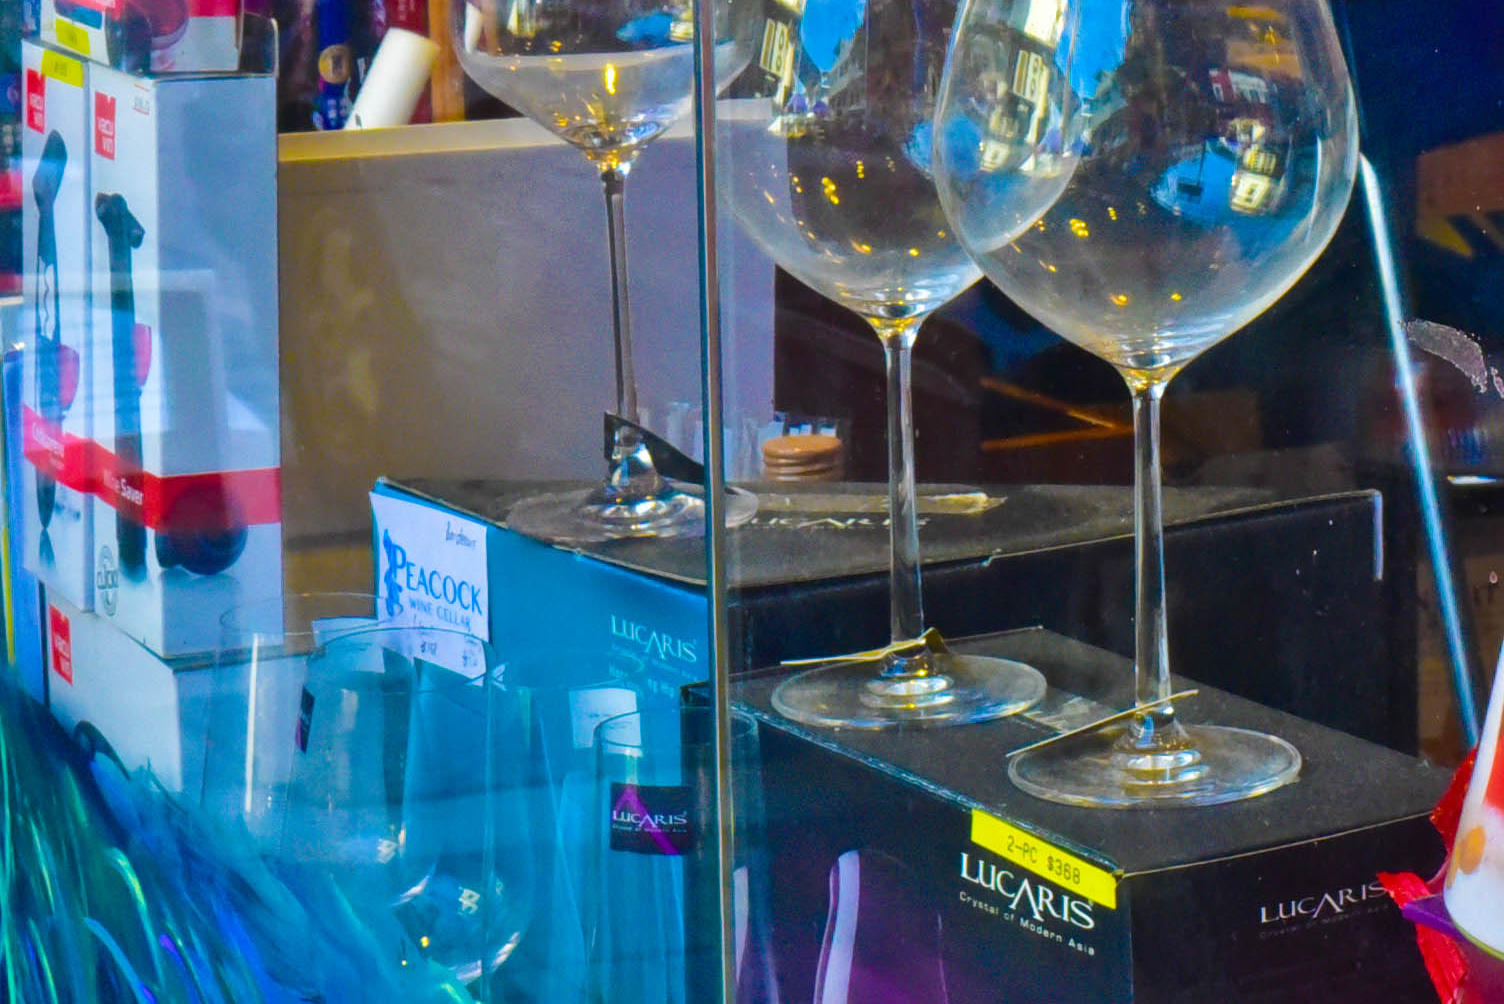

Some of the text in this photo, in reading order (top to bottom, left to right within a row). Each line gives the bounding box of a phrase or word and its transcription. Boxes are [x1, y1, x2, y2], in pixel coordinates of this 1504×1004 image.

[391, 542, 483, 616] PEACOCK
[409, 597, 472, 631] WINE CELLAR
[611, 614, 697, 663] LUCARIS
[612, 810, 688, 828] LUCARIS
[1006, 835, 1038, 864] 2-PC
[960, 852, 1095, 929] LUCARIS
[1260, 881, 1388, 924] LUCARIS
[959, 890, 1096, 957] Crystal of Modern Asia
